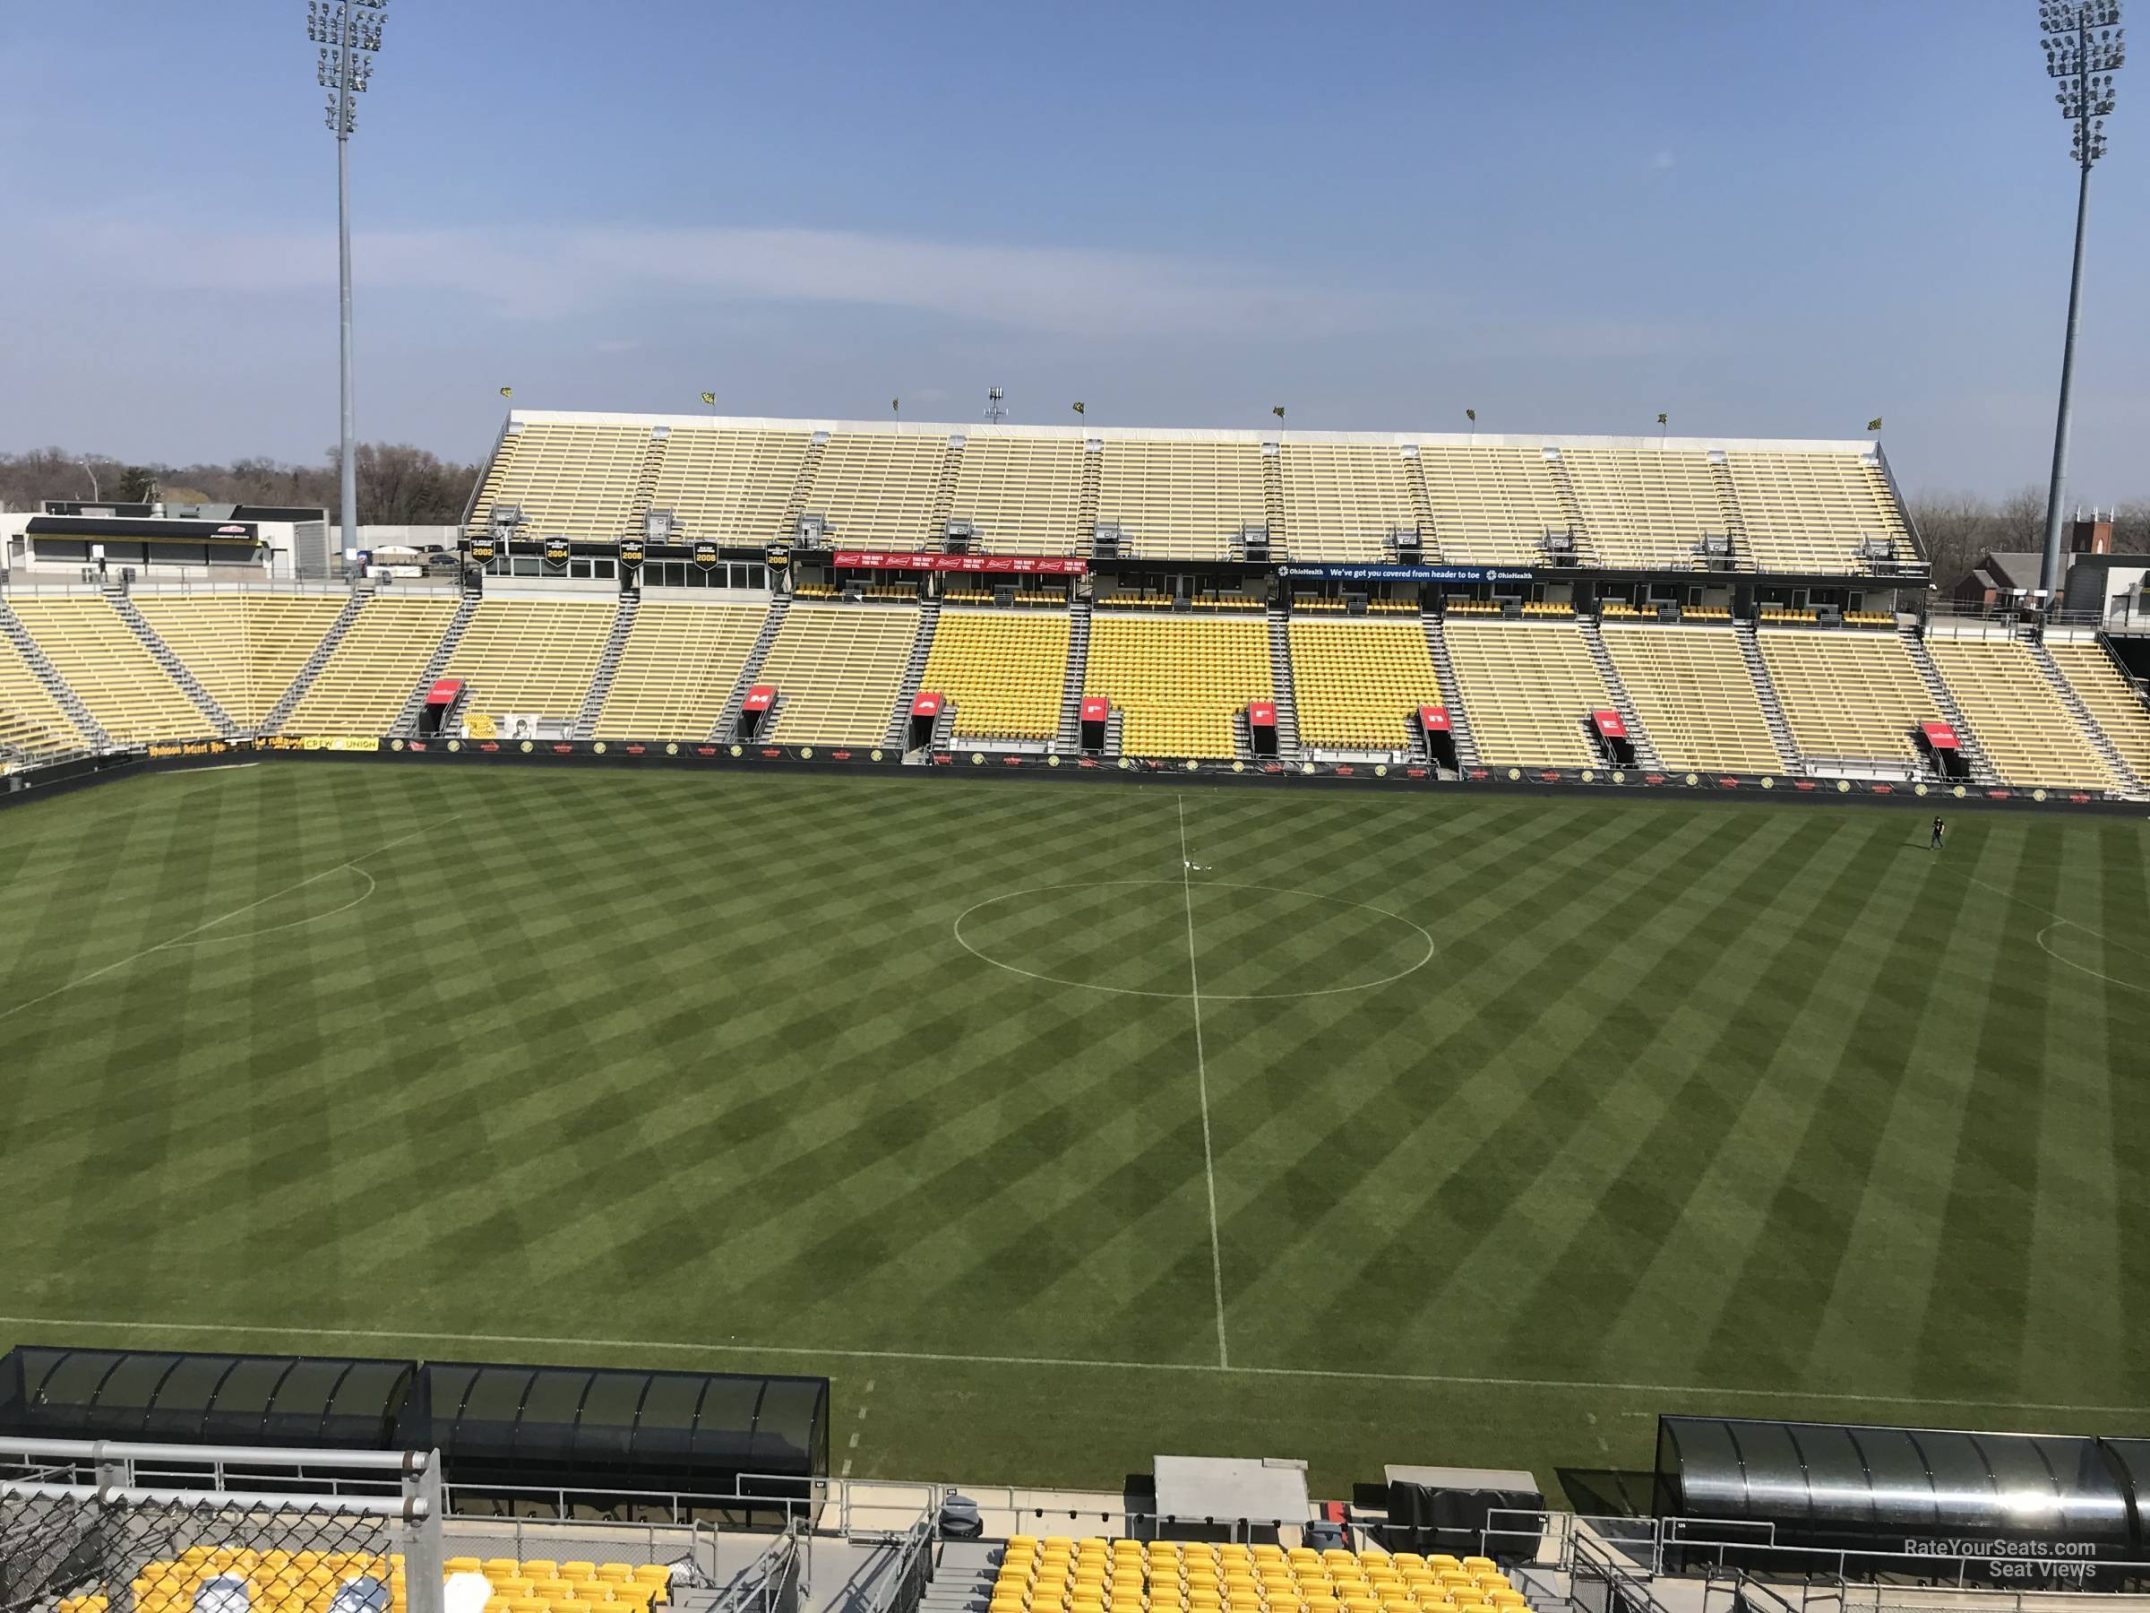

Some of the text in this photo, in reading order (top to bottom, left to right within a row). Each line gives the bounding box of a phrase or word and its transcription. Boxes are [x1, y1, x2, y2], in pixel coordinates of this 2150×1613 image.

[472, 548, 493, 556] 2002
[548, 550, 568, 558] 2004
[1330, 568, 1352, 576] We've
[1353, 569, 1366, 578] got
[1412, 570, 1430, 578] from
[1432, 570, 1456, 578] header
[306, 739, 333, 748] CREW
[346, 740, 376, 748] UNION
